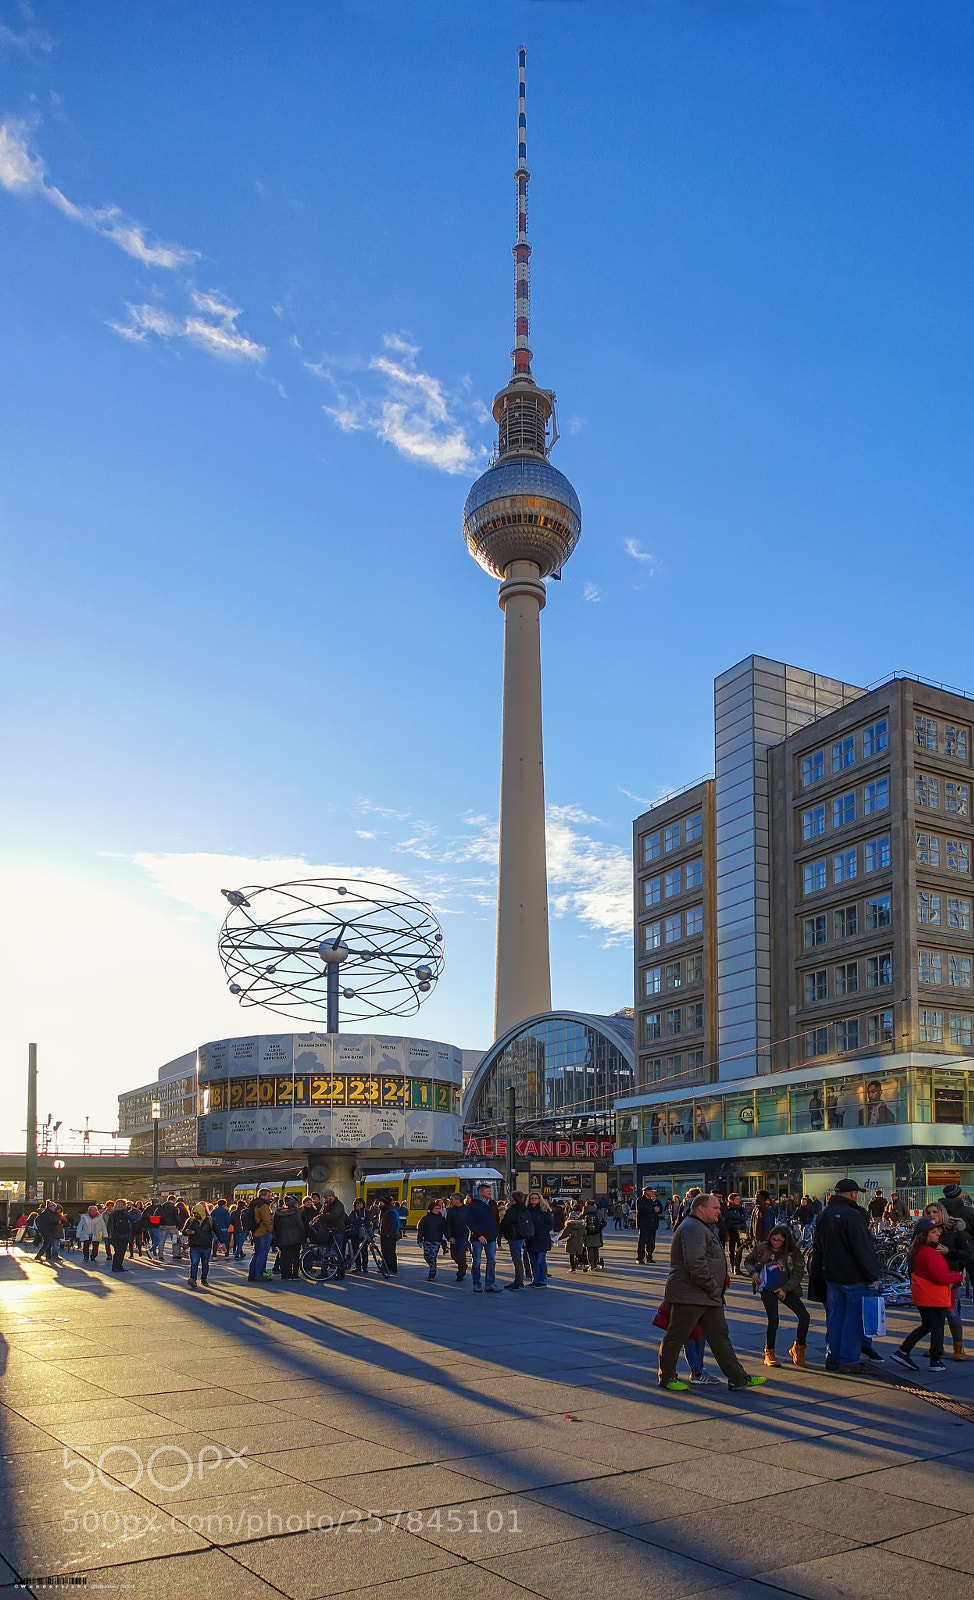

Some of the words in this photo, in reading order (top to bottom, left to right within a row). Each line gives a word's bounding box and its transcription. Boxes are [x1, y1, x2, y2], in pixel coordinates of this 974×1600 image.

[210, 1088, 221, 1107] 18
[245, 1083, 274, 1103] 20
[278, 1081, 304, 1100] 21
[312, 1081, 344, 1100] 22
[349, 1081, 379, 1100] 23
[384, 1082, 410, 1102] 24
[419, 1085, 428, 1103] 1
[439, 1088, 448, 1106] 2
[863, 1178, 880, 1188] dm
